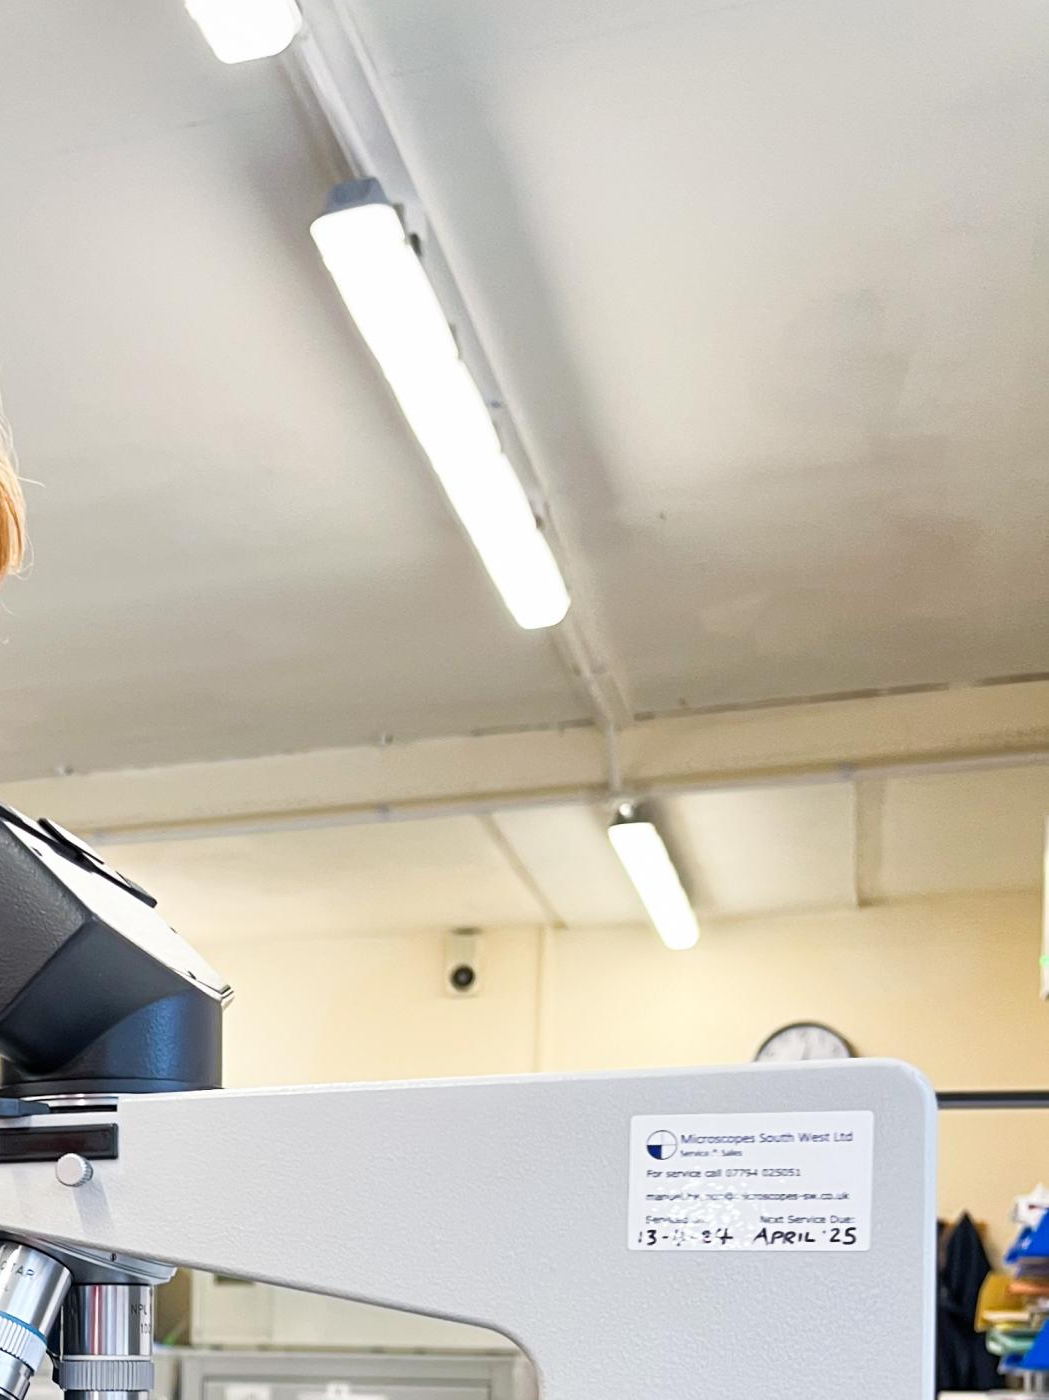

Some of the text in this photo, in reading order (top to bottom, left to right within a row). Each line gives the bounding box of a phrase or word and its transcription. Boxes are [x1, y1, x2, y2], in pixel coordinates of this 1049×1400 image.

[680, 1131, 854, 1146] Microscopes South West Ltd
[646, 1167, 801, 1178] For service call 07794 025051
[759, 1215, 784, 1224] Next
[787, 1215, 827, 1224] Service
[752, 1227, 817, 1246] APRIL
